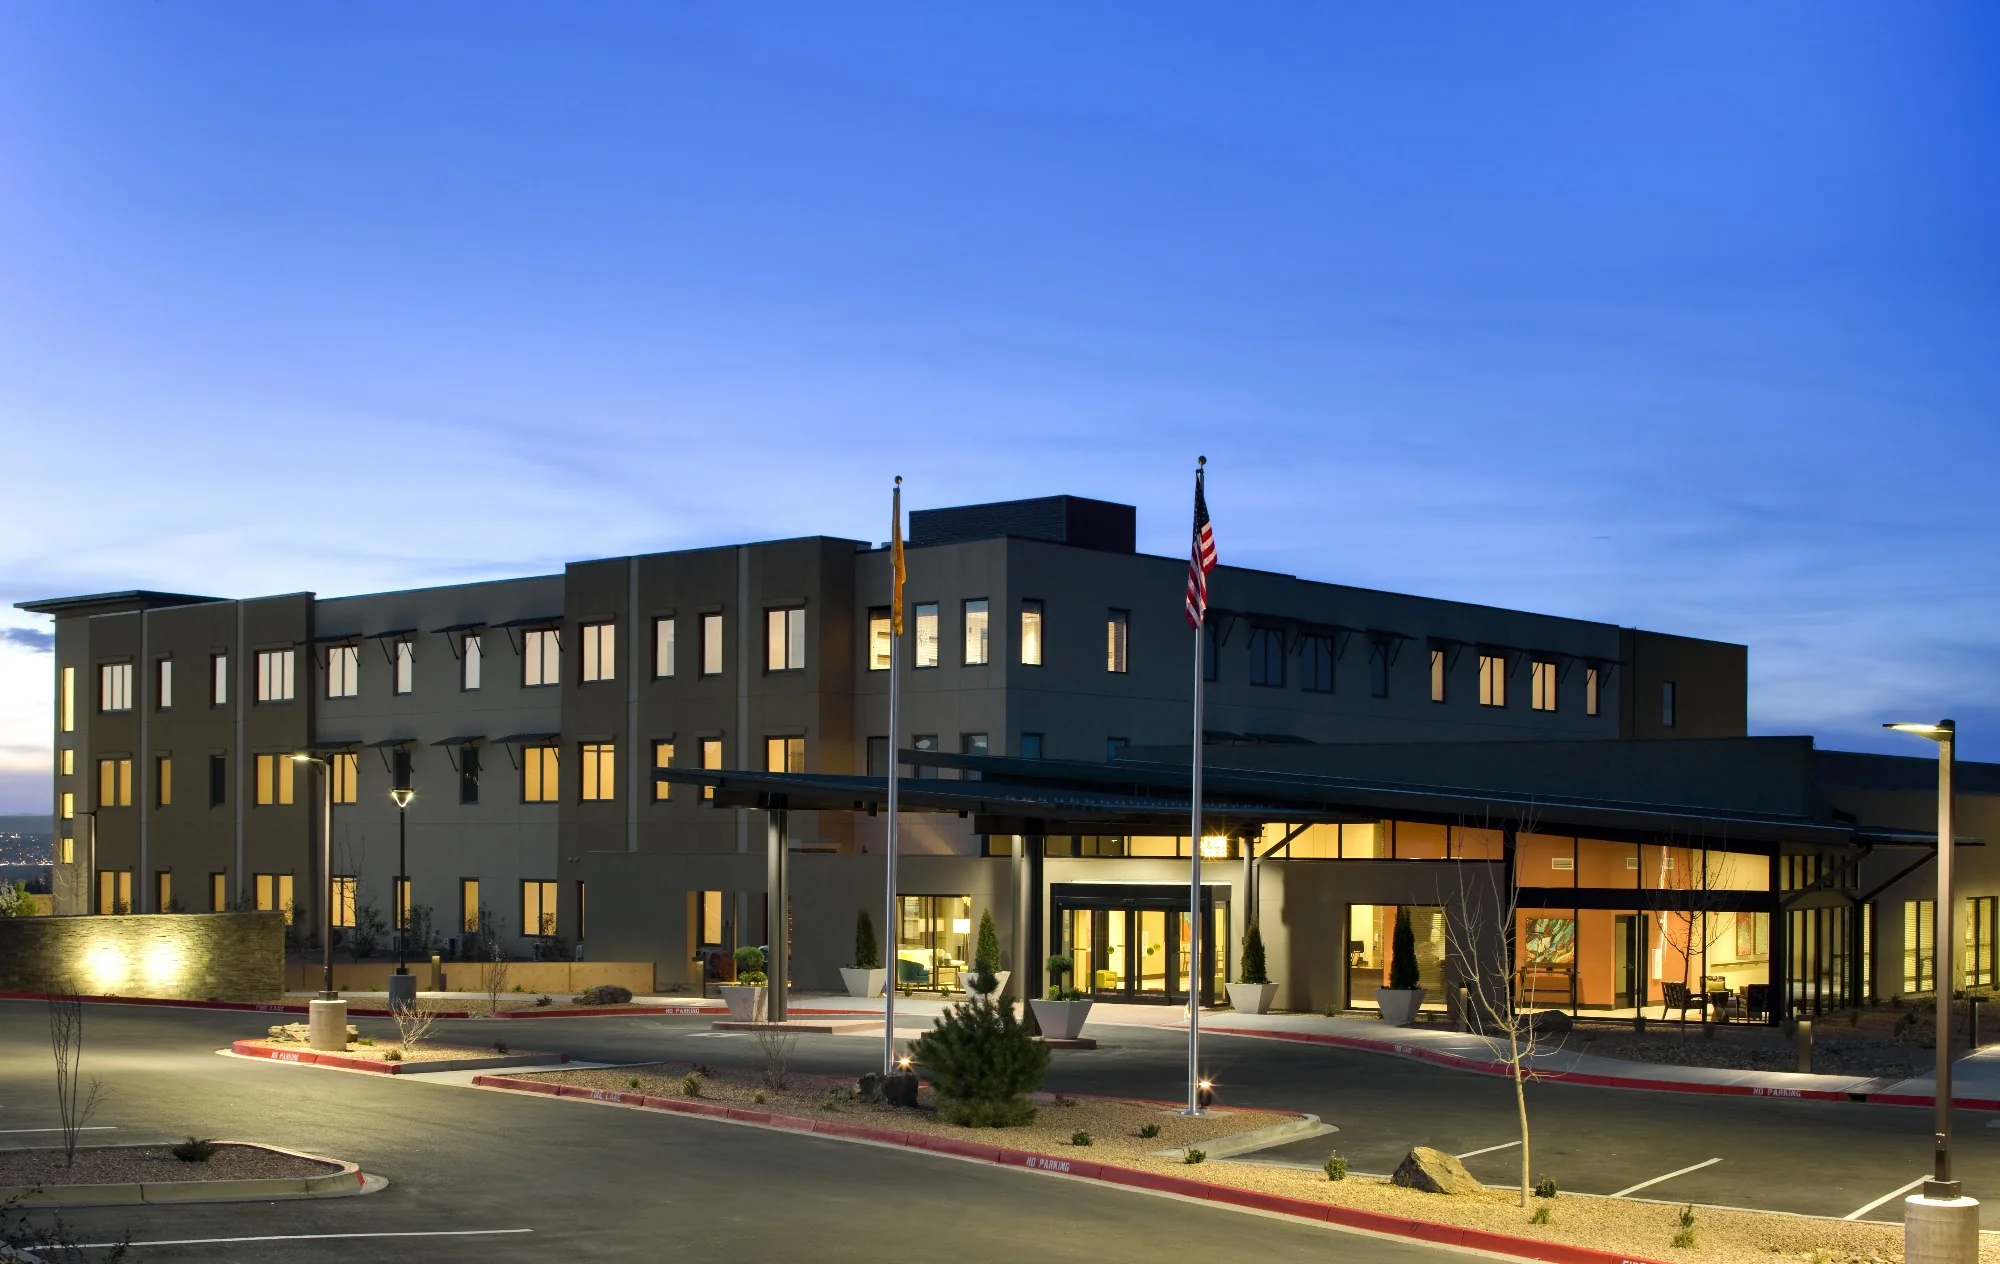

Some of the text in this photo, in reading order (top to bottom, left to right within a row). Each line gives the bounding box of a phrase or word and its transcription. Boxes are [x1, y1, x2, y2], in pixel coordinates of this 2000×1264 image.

[1753, 1087, 1801, 1097] NO PARKING
[1026, 1156, 1070, 1172] NO PARKING
